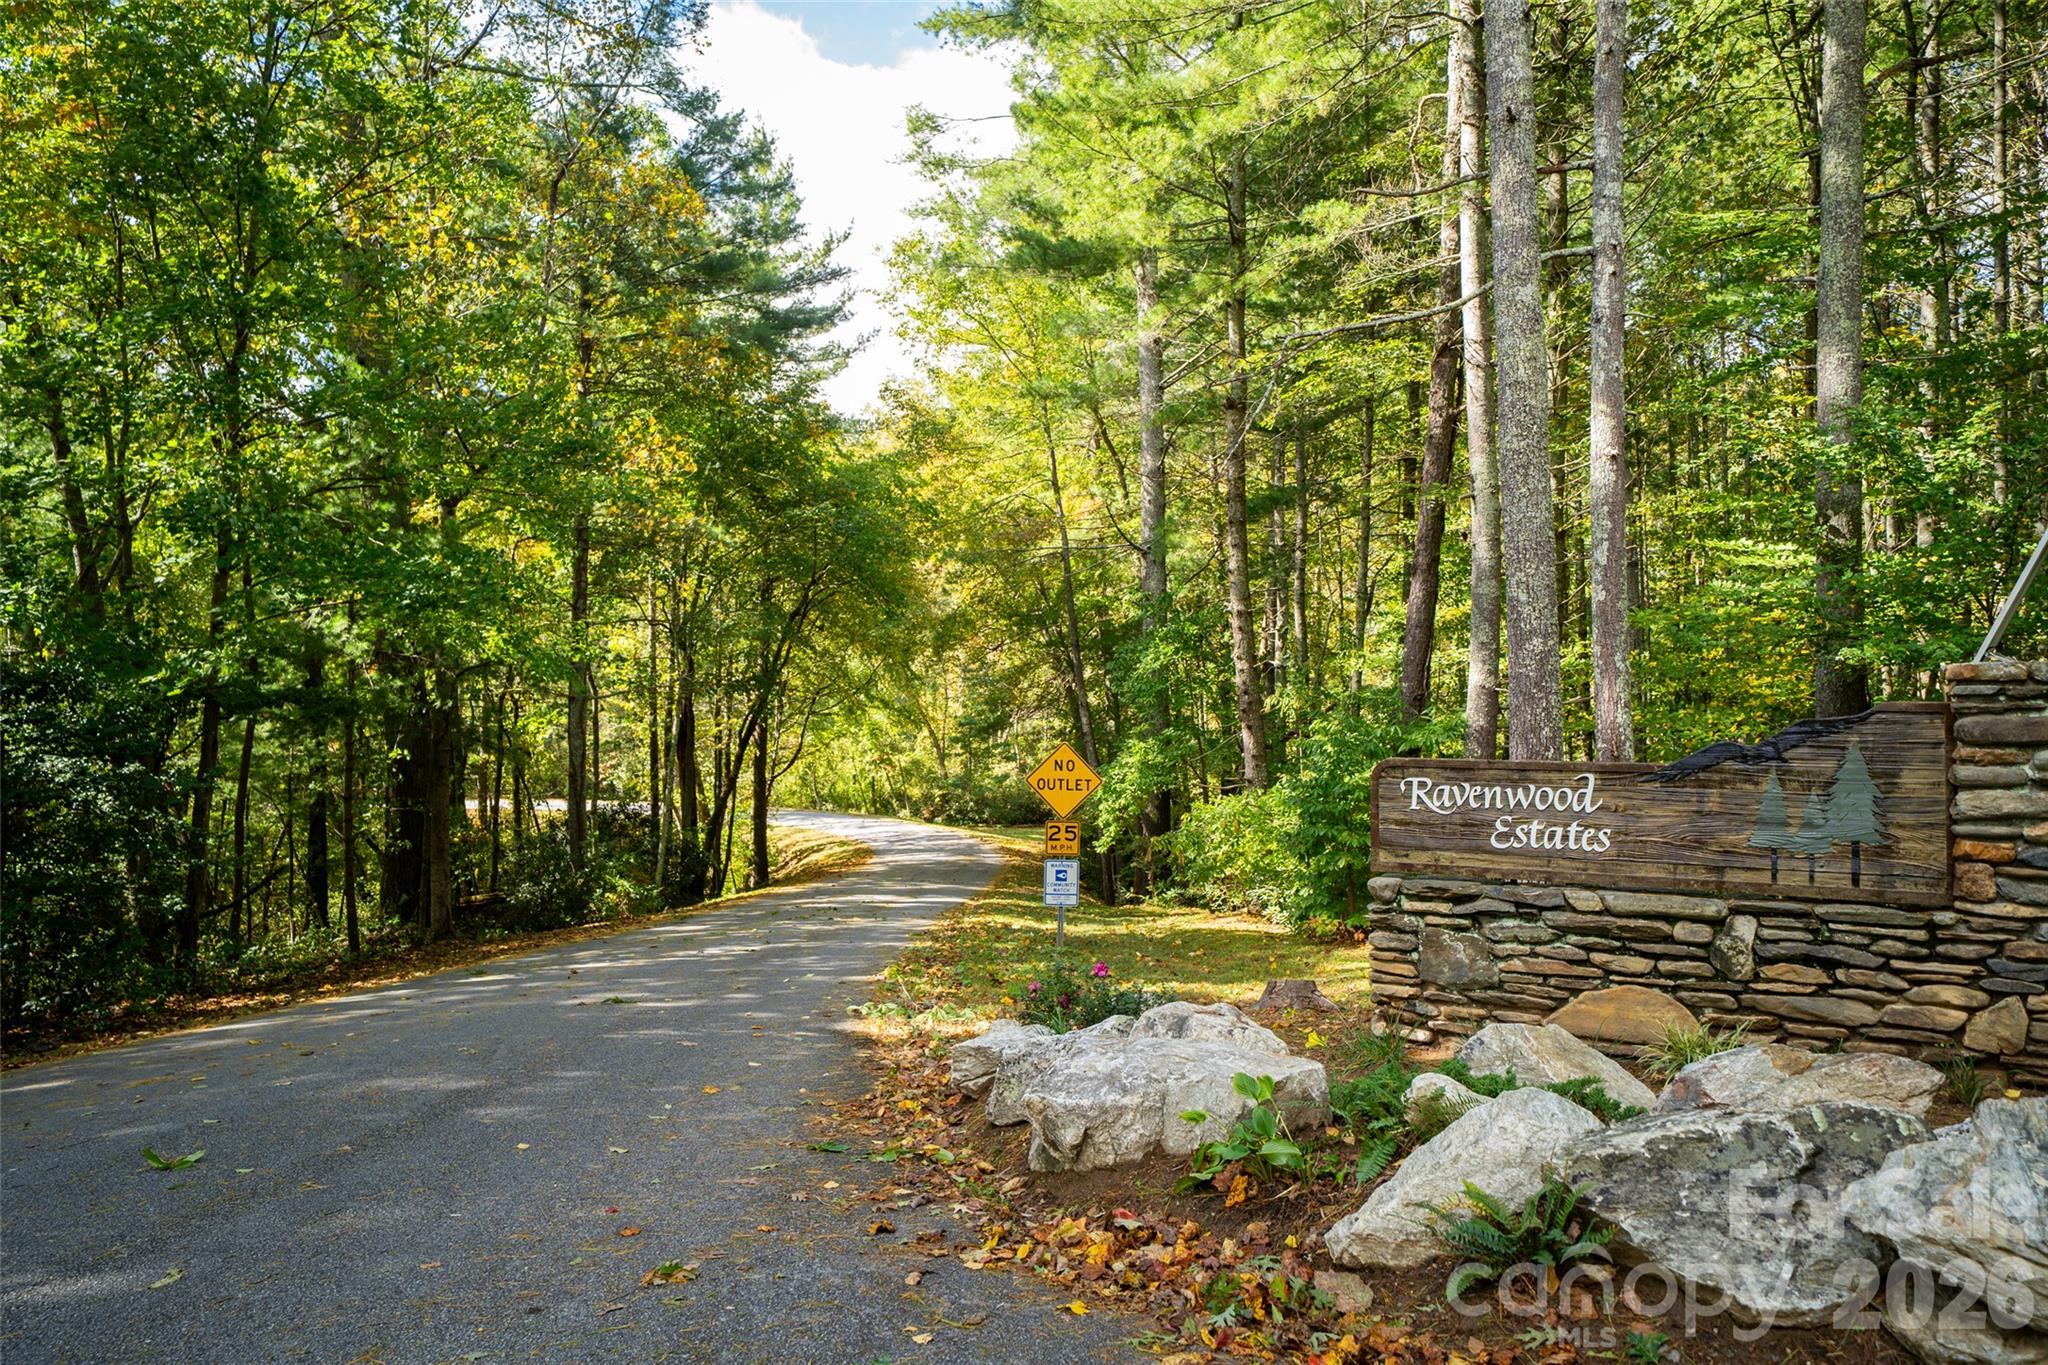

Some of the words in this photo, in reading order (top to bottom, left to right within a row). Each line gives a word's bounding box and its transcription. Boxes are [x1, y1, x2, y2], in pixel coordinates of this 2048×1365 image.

[1054, 759, 1075, 772] NO
[1037, 778, 1092, 791] OUTLET
[1400, 773, 1603, 815] Ravenwood
[1048, 825, 1077, 842] 25
[1490, 815, 1611, 852] Estates
